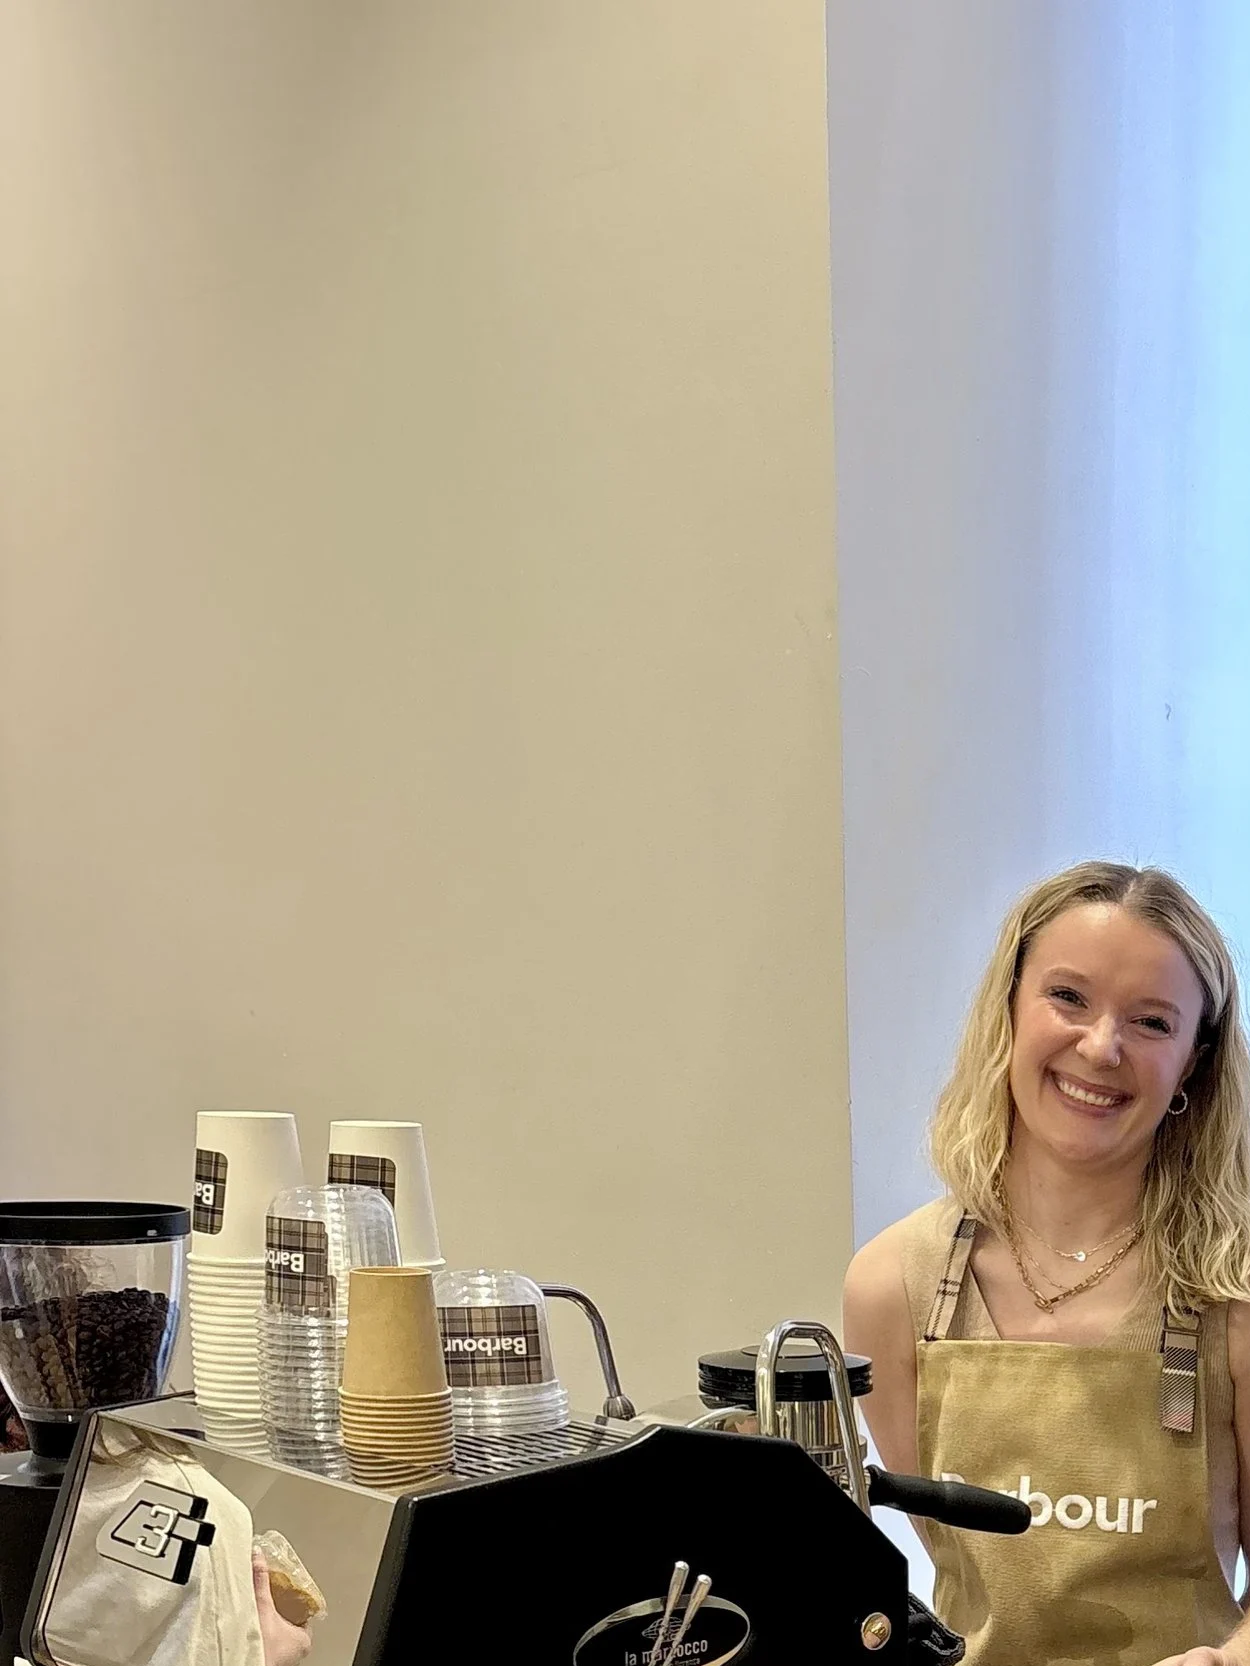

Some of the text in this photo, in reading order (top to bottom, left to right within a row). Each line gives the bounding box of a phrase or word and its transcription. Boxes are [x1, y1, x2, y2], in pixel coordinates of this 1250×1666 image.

[444, 1336, 527, 1357] Barbour
[941, 1472, 1158, 1534] bour
[624, 1639, 708, 1666] la marocco
